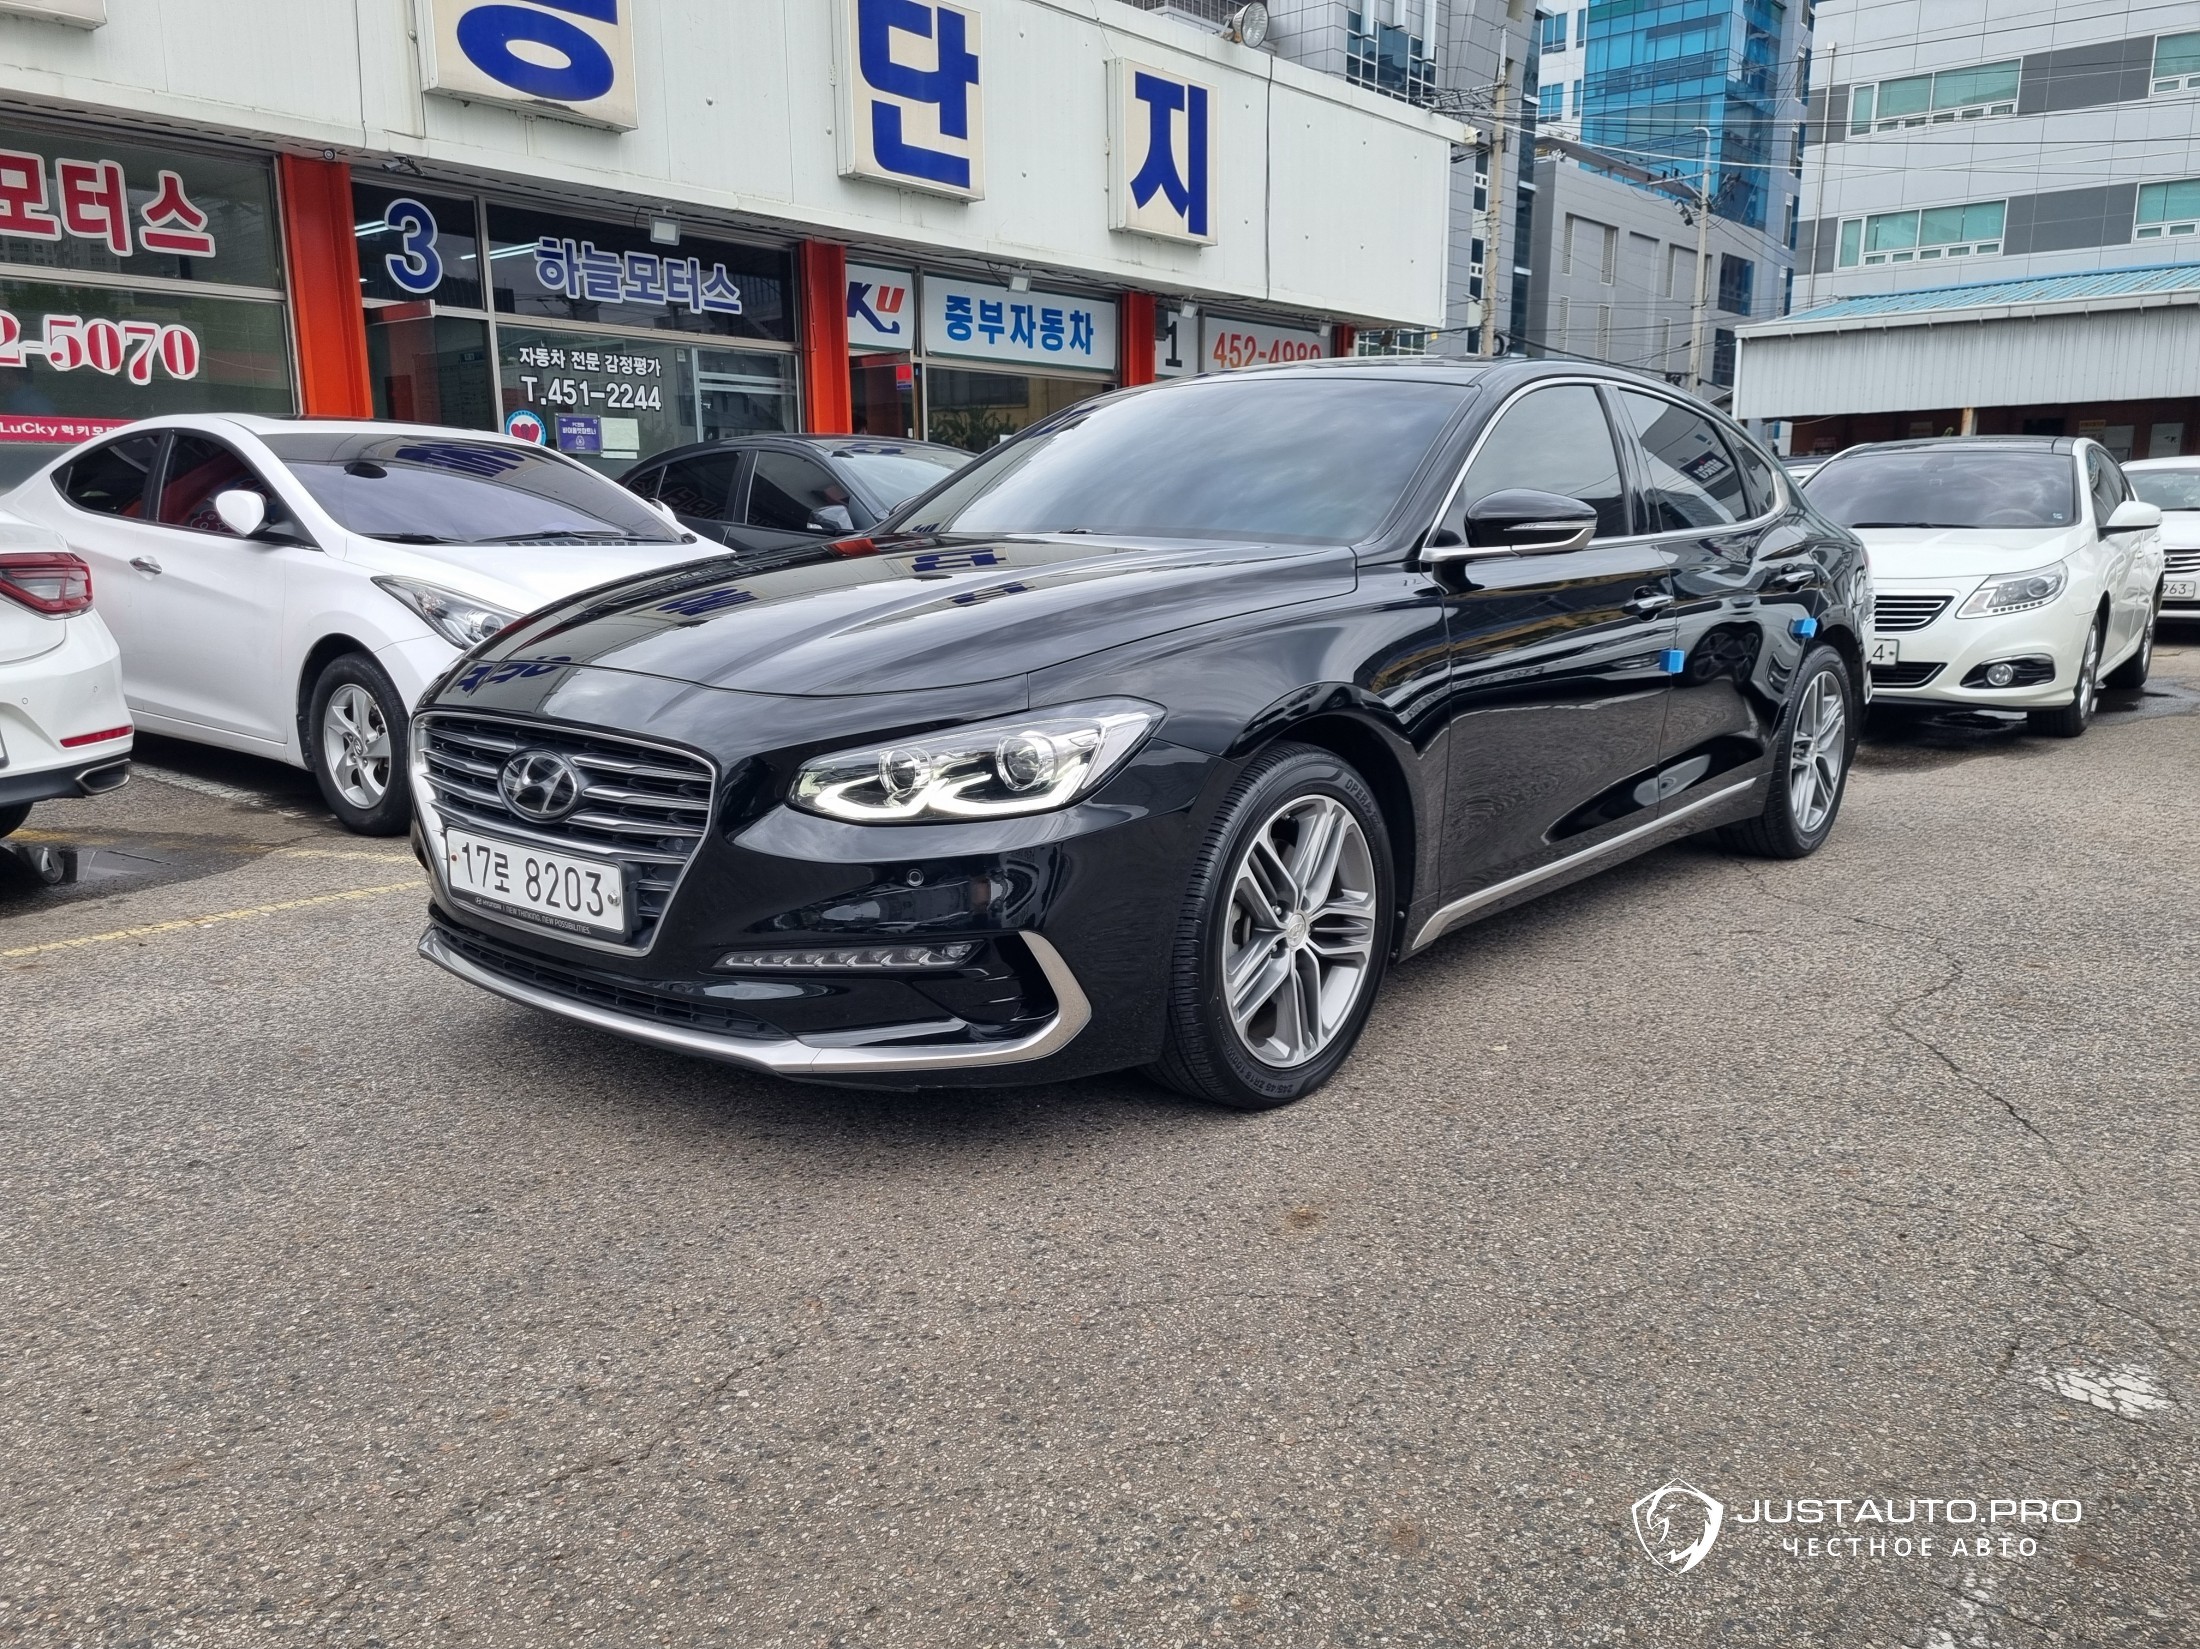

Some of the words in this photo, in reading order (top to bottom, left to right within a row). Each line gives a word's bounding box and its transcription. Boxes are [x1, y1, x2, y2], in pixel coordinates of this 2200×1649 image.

[858, 0, 979, 189] 단
[1130, 71, 1208, 236] 지
[0, 149, 216, 258] 모터스
[384, 198, 443, 293] 3
[534, 236, 742, 314] 하늘모터스
[519, 347, 566, 369] 자동차
[570, 351, 600, 371] 전문
[604, 354, 662, 377] 감정평가
[945, 295, 1094, 355] 중부자동차
[1165, 321, 1183, 368] 1
[520, 376, 662, 411] T.451-2244
[462, 842, 511, 893] 17로
[525, 857, 604, 917] 8203
